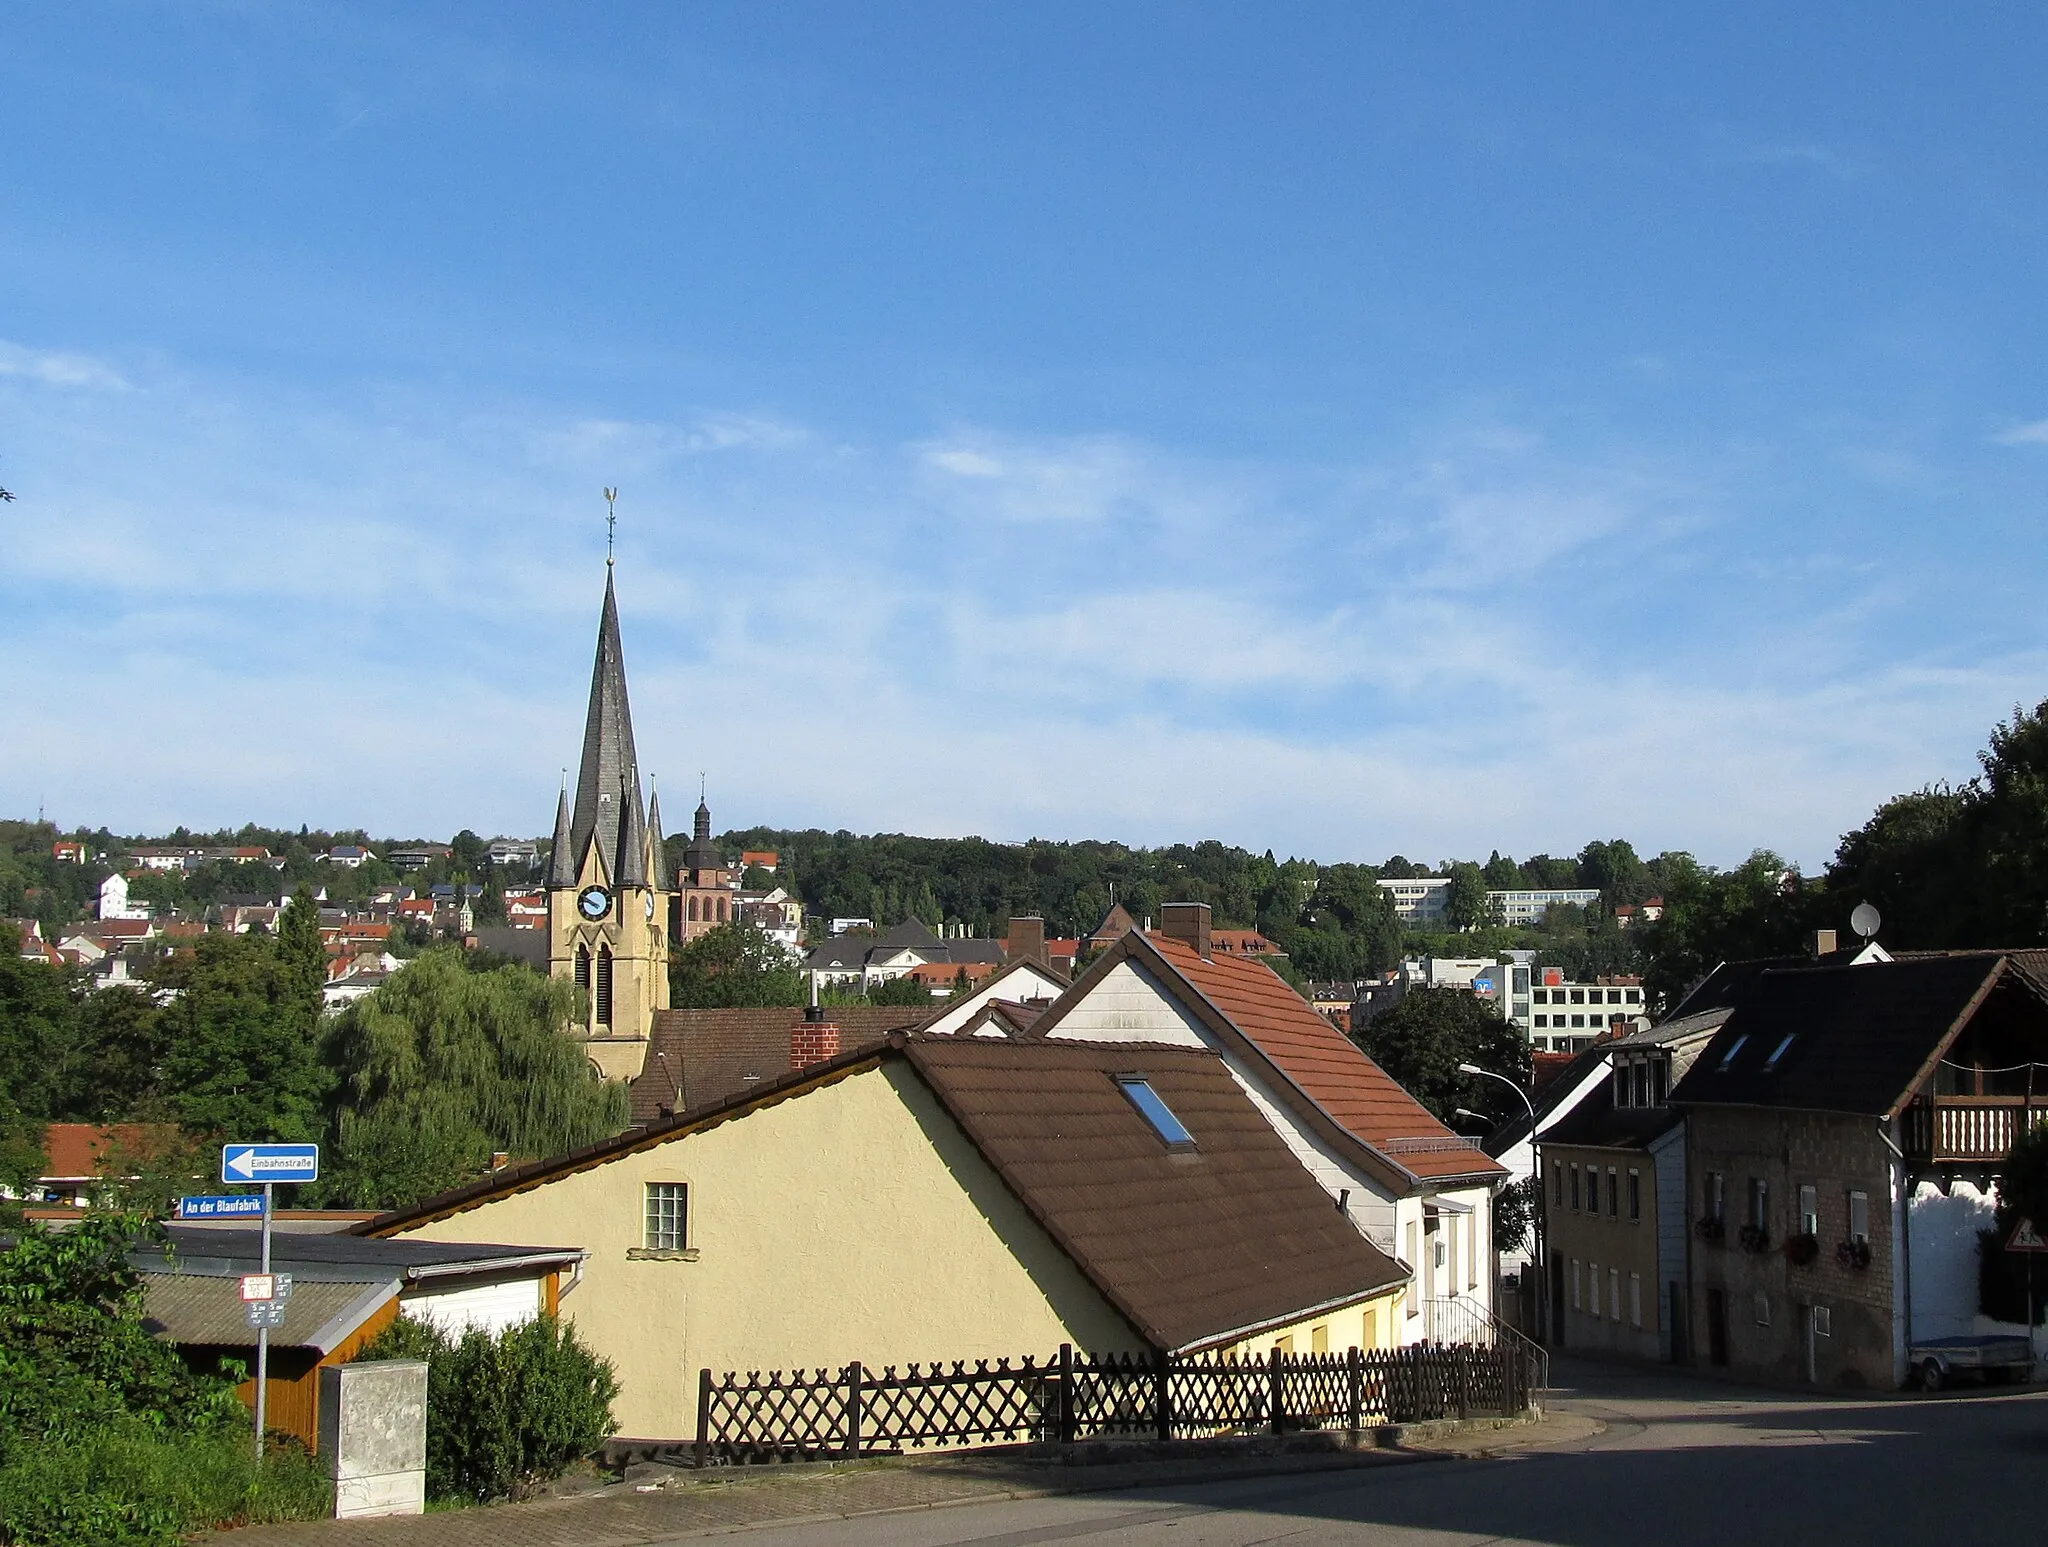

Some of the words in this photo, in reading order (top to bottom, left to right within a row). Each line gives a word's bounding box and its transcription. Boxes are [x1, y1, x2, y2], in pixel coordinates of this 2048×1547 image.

[251, 1158, 312, 1168] Einbahnstraße
[186, 1202, 198, 1213] An
[200, 1201, 214, 1213] der
[217, 1199, 261, 1212] Blaufabrik
